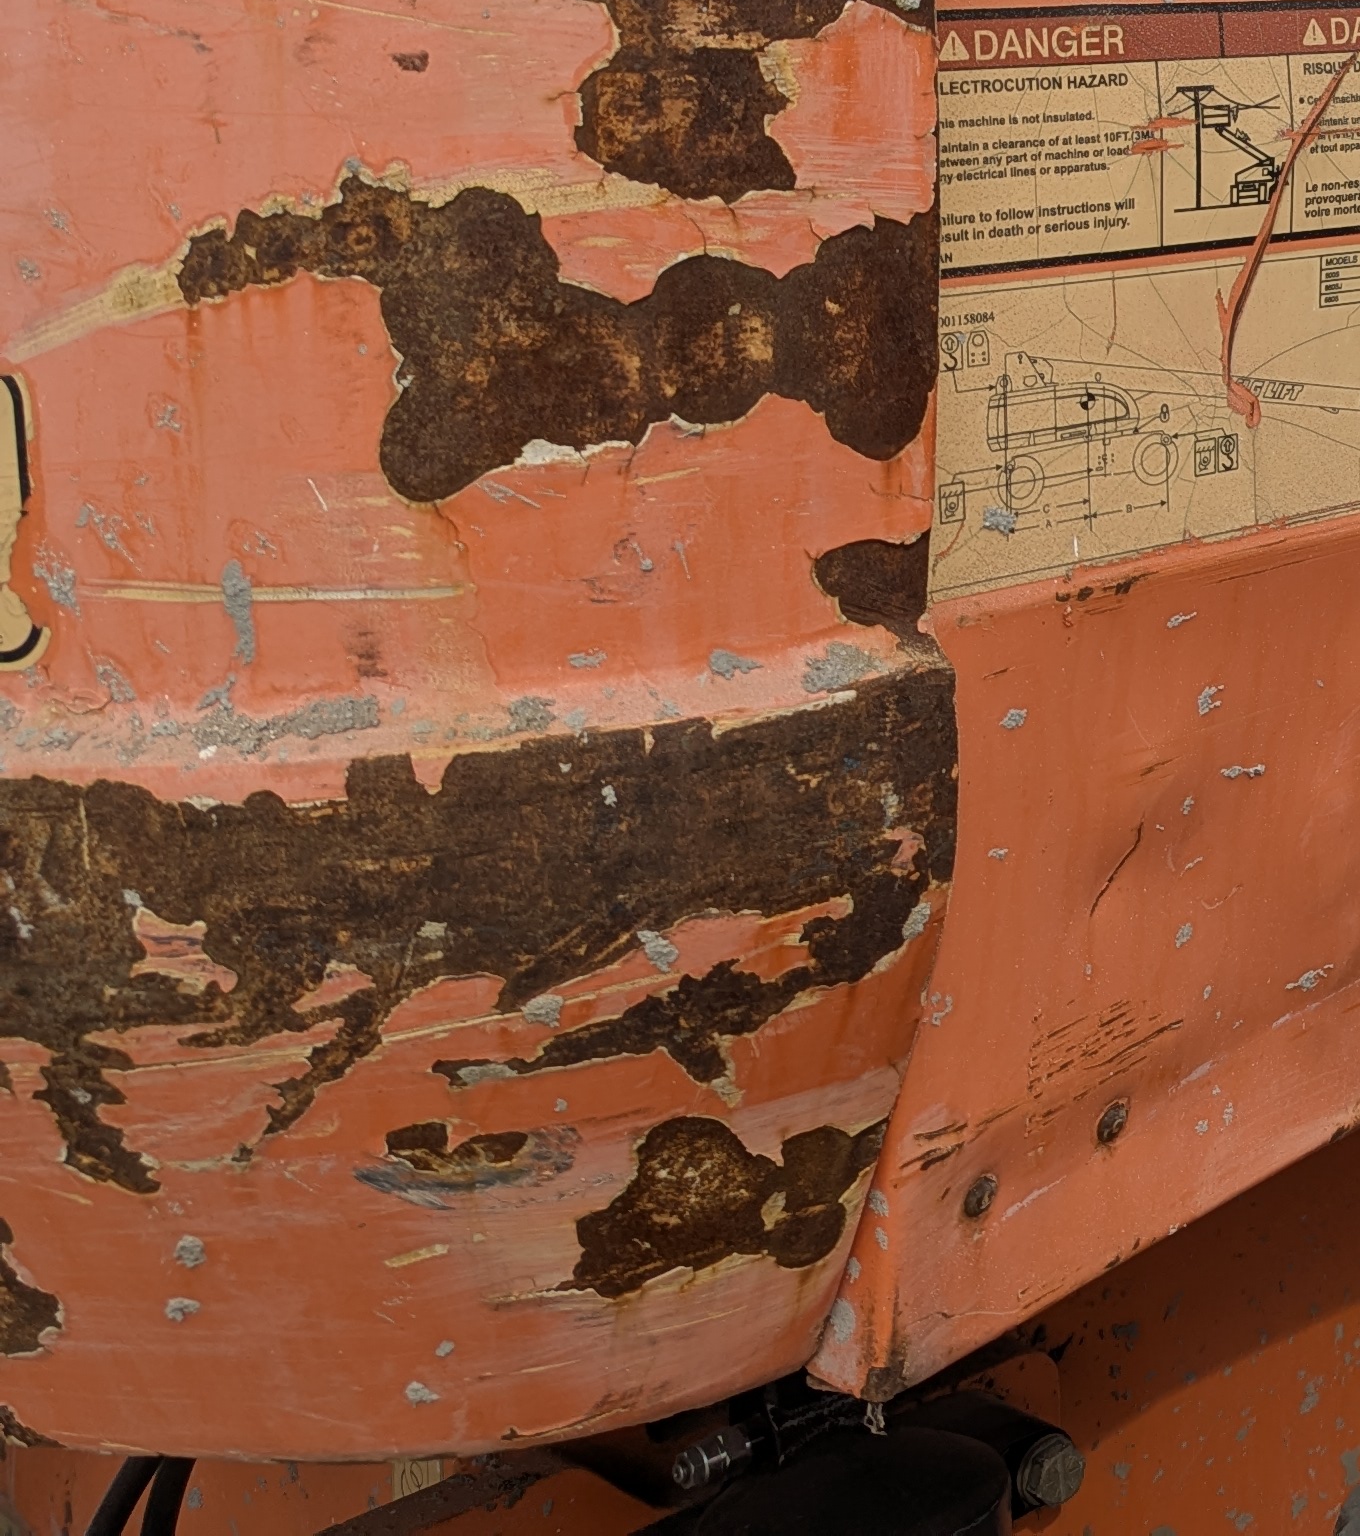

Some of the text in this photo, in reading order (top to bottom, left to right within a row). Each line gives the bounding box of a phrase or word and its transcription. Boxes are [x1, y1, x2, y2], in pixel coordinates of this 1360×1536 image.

[974, 25, 1125, 61] DANGER
[1303, 60, 1351, 75] RISQU
[940, 73, 1129, 95] LECTROCUTION HAZARD
[958, 115, 1005, 129] machine
[1009, 114, 1019, 124] is
[1022, 113, 1040, 124] not
[1042, 110, 1095, 123] insulated.
[1318, 115, 1349, 127] intenir
[941, 141, 980, 154] aintain
[983, 142, 989, 151] a
[992, 138, 1045, 150] clearance
[1048, 135, 1060, 146] of
[1062, 135, 1072, 146] at
[1075, 133, 1100, 145] least
[1310, 144, 1319, 154] et
[1321, 143, 1338, 153] tout
[940, 145, 1130, 168] etween any part of machine or load
[940, 162, 1110, 185] ny electrical lines or apparatus.
[1306, 182, 1318, 193] Le
[941, 198, 1136, 227] ilure to follow instructions will
[1304, 207, 1331, 219] voire
[941, 216, 1131, 244] sult in death or serious injury.
[1325, 255, 1359, 267] MODELS
[939, 311, 995, 328] 01158084
